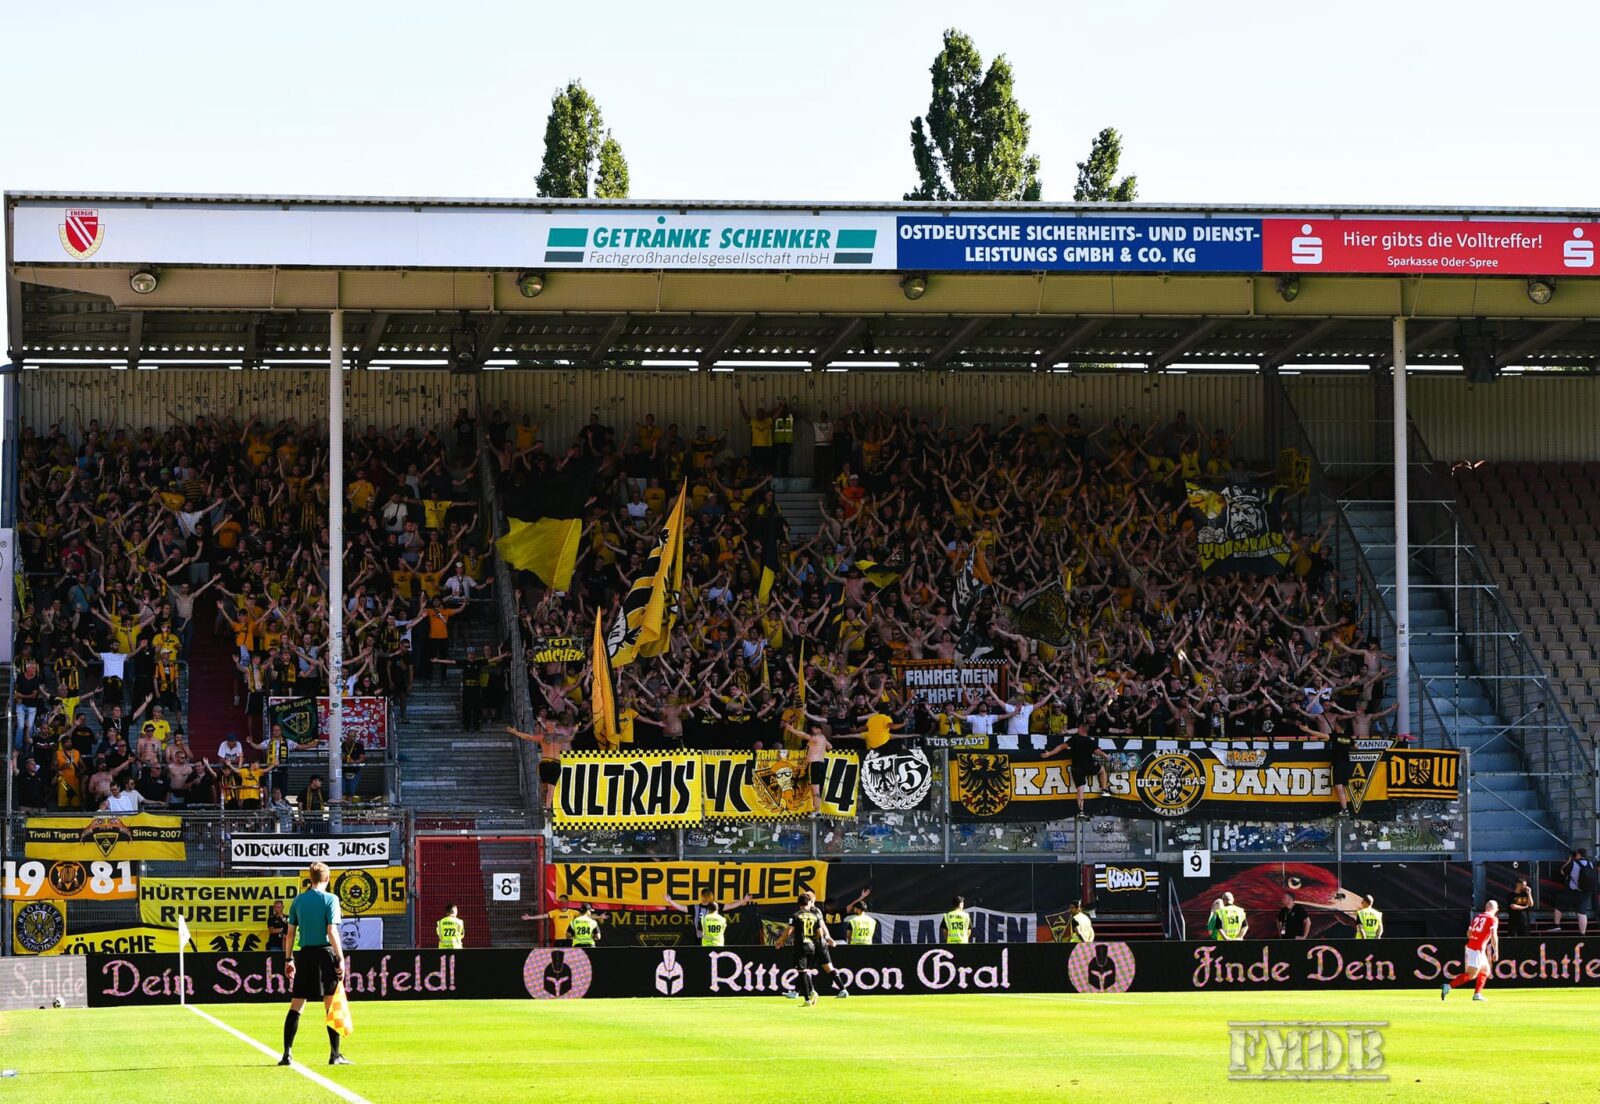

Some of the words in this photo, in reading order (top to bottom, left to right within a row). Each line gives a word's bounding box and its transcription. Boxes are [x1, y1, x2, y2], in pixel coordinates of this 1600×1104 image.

[719, 228, 831, 250] SCHENKER
[899, 224, 1020, 242] OSTDEUTSCHE
[1026, 225, 1143, 242] SICHERHEITS-
[1149, 227, 1187, 242] UND
[1192, 227, 1261, 243] DIENST-
[1343, 231, 1377, 248] Hier
[1382, 232, 1424, 251] gibts
[1427, 232, 1454, 248] die
[1456, 233, 1544, 249] Volltreffer!
[589, 251, 791, 266] Fachgroßhandelsgesellschaft
[796, 253, 830, 265] mbH
[964, 247, 1058, 263] LEISTUNGS
[1063, 248, 1115, 263] GMBH
[1119, 248, 1133, 263] &
[1138, 249, 1167, 264] CO.
[1172, 249, 1197, 264] KG
[1386, 256, 1439, 269] Sparkasse
[1440, 257, 1499, 269] Oder-Spree
[926, 736, 949, 747] FÜR
[950, 736, 985, 747] STADT
[1212, 764, 1333, 797] BANDE
[560, 762, 695, 817] ULTRAS
[29, 831, 51, 839] Tivoli
[54, 831, 80, 840] Tigers
[132, 829, 158, 838] Since
[160, 830, 182, 838] 2007
[1190, 855, 1202, 872] 9
[502, 878, 512, 896] 8
[565, 860, 816, 900] KAPPEHÄUER
[141, 885, 298, 901] HÜRTGENWALD
[160, 905, 275, 923] RUREIFE
[443, 928, 456, 936] 272
[577, 927, 591, 935] 284
[707, 925, 721, 933] 109
[893, 910, 1027, 943] AAHEN
[951, 922, 964, 930] 135
[917, 948, 1011, 990] Gral
[1192, 945, 1290, 988] Finde
[1307, 945, 1397, 981] Dein
[102, 959, 195, 996] Dein
